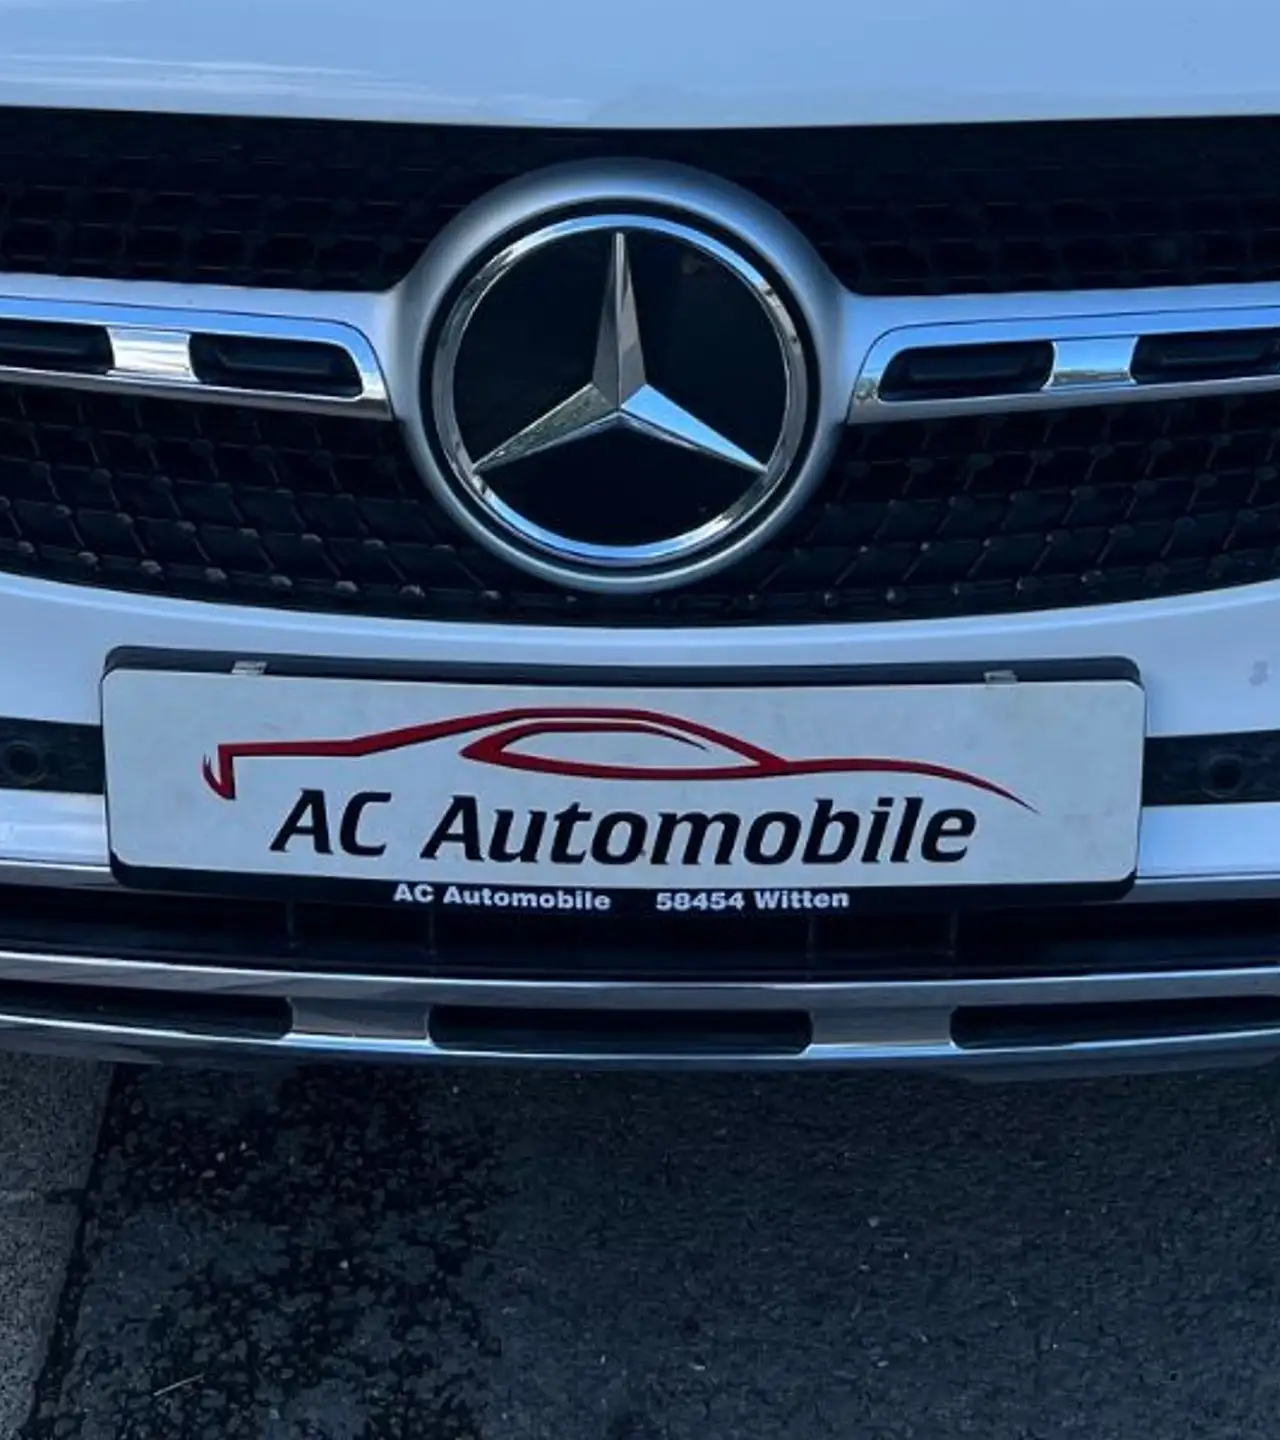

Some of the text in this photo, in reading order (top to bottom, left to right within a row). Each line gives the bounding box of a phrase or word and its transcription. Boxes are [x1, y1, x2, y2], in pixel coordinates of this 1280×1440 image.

[269, 788, 977, 865] AC Automobile
[392, 882, 851, 911] AC Automobile 58454 Witten
